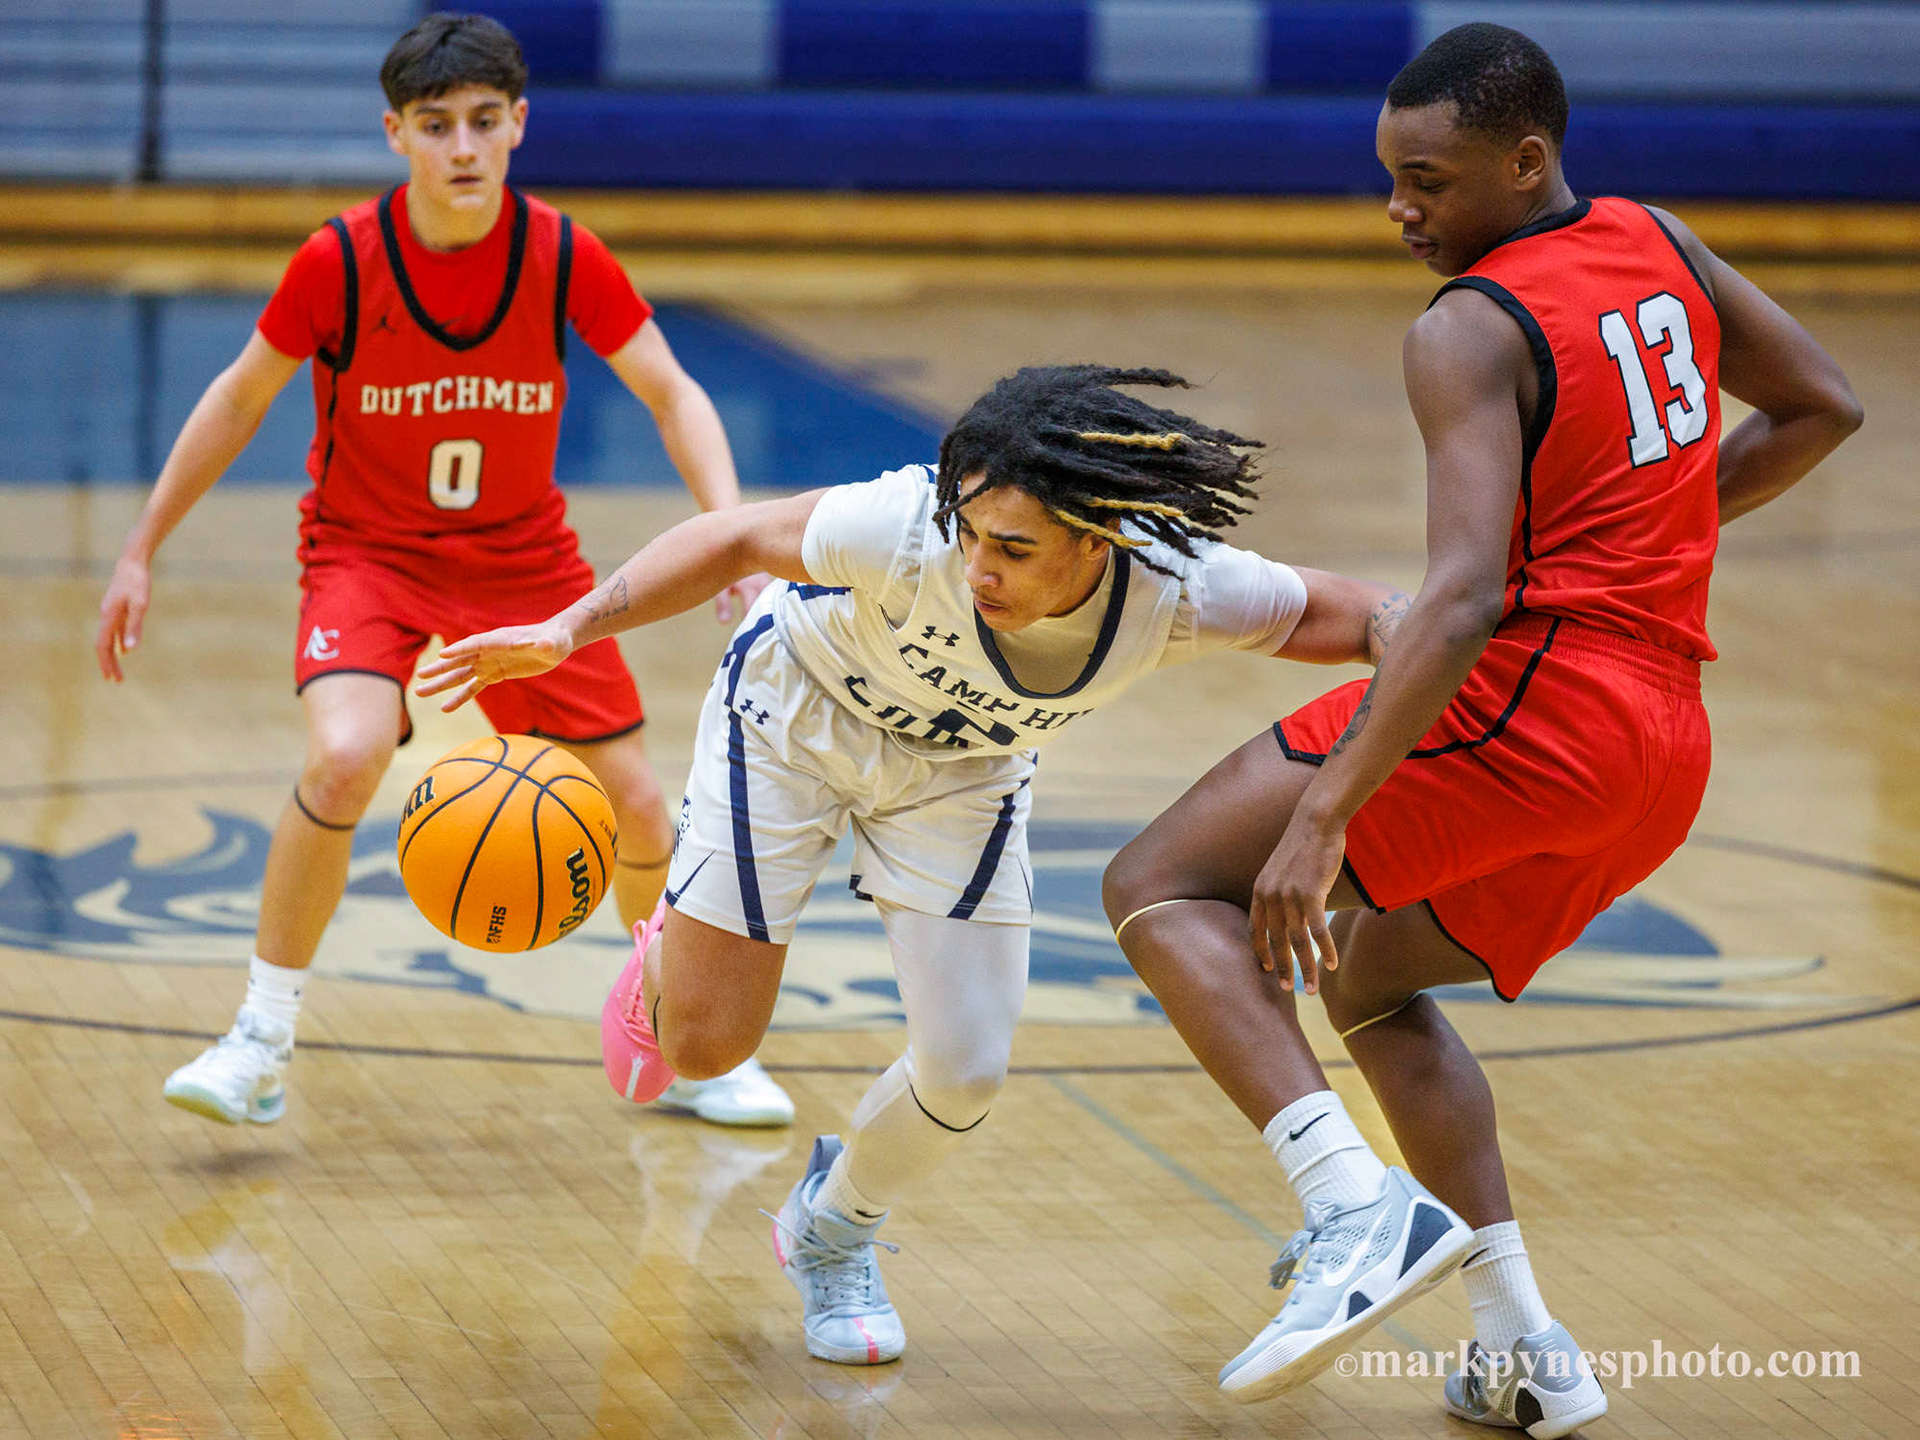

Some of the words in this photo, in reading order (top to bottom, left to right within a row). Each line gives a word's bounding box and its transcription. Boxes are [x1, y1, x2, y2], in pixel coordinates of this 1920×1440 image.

[360, 374, 554, 417] DUTCHMEN
[1598, 290, 1709, 471] 13
[428, 437, 484, 511] 0
[487, 905, 507, 940] NFHS
